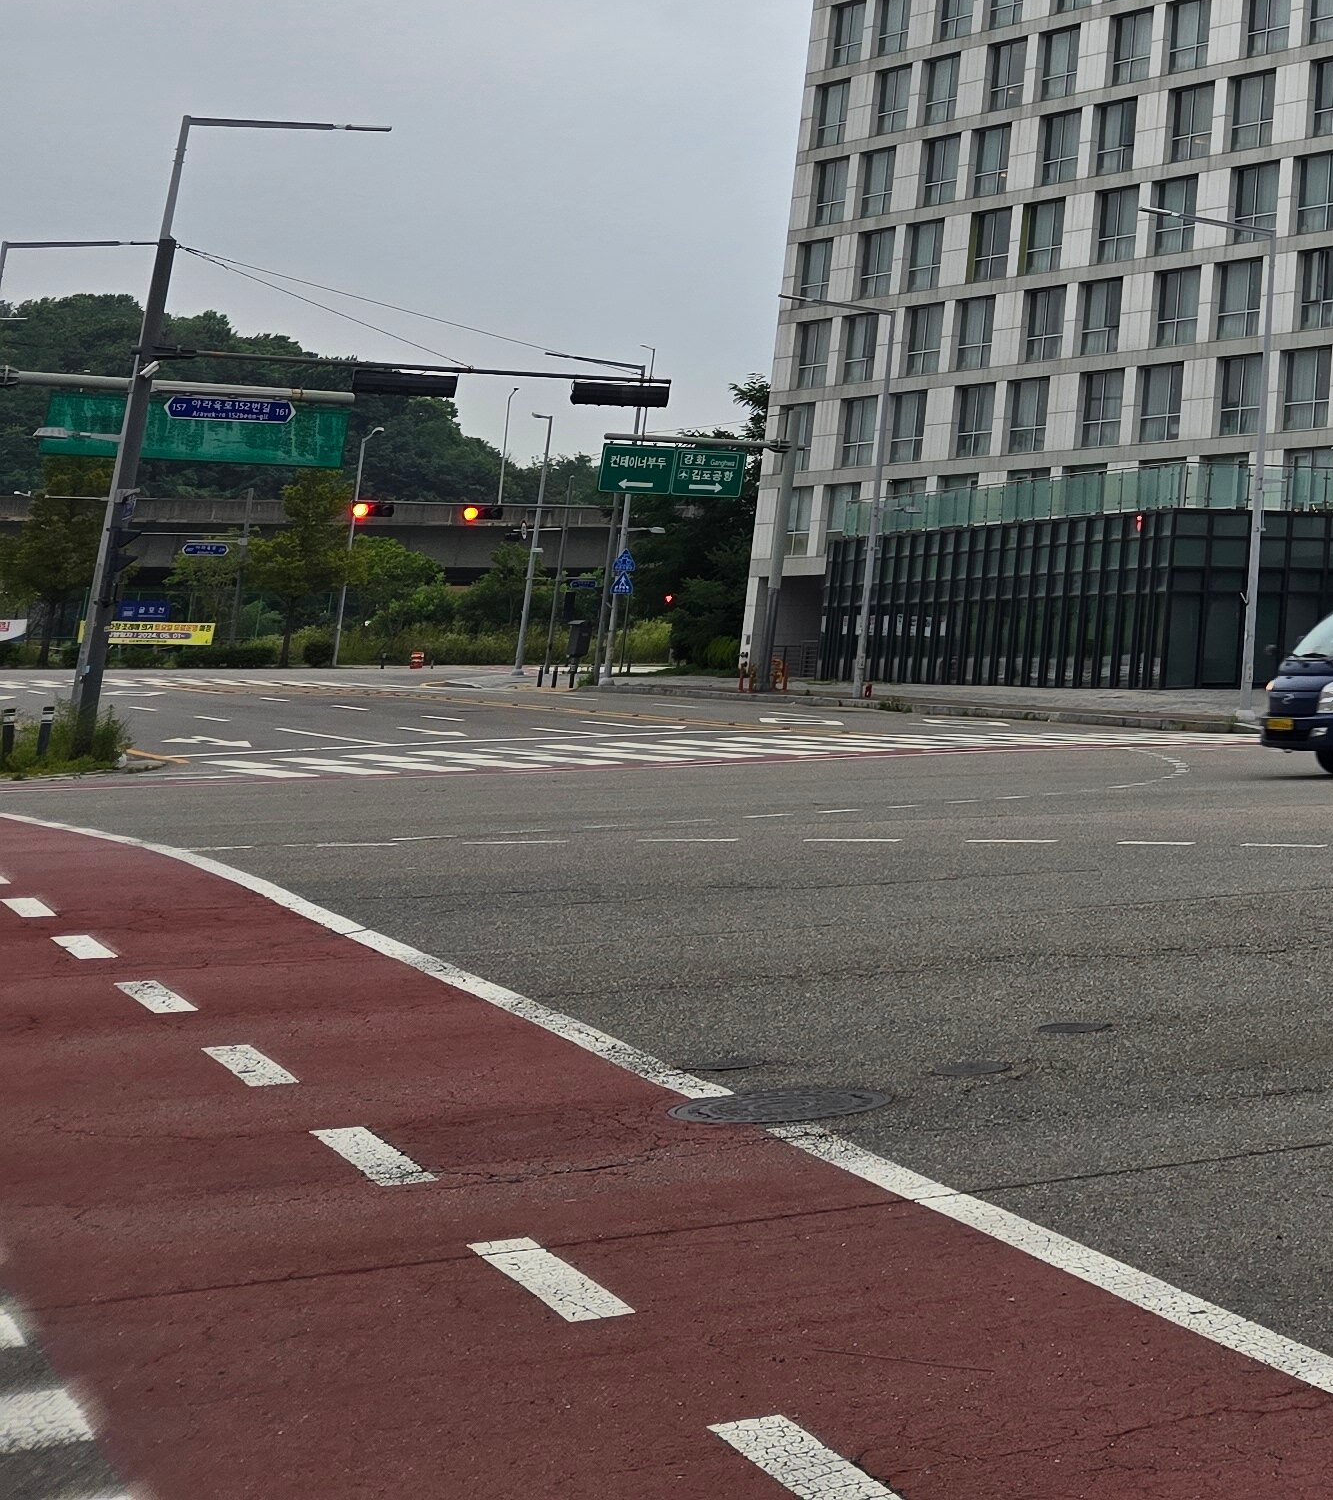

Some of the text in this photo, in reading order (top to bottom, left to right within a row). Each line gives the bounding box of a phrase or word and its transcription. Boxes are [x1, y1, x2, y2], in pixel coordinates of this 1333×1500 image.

[172, 403, 187, 411] 157
[275, 408, 289, 416] 161
[609, 455, 667, 469] 컨테이너부두
[684, 454, 735, 468] 강화 Ganghwa
[691, 469, 734, 482] 김포공항
